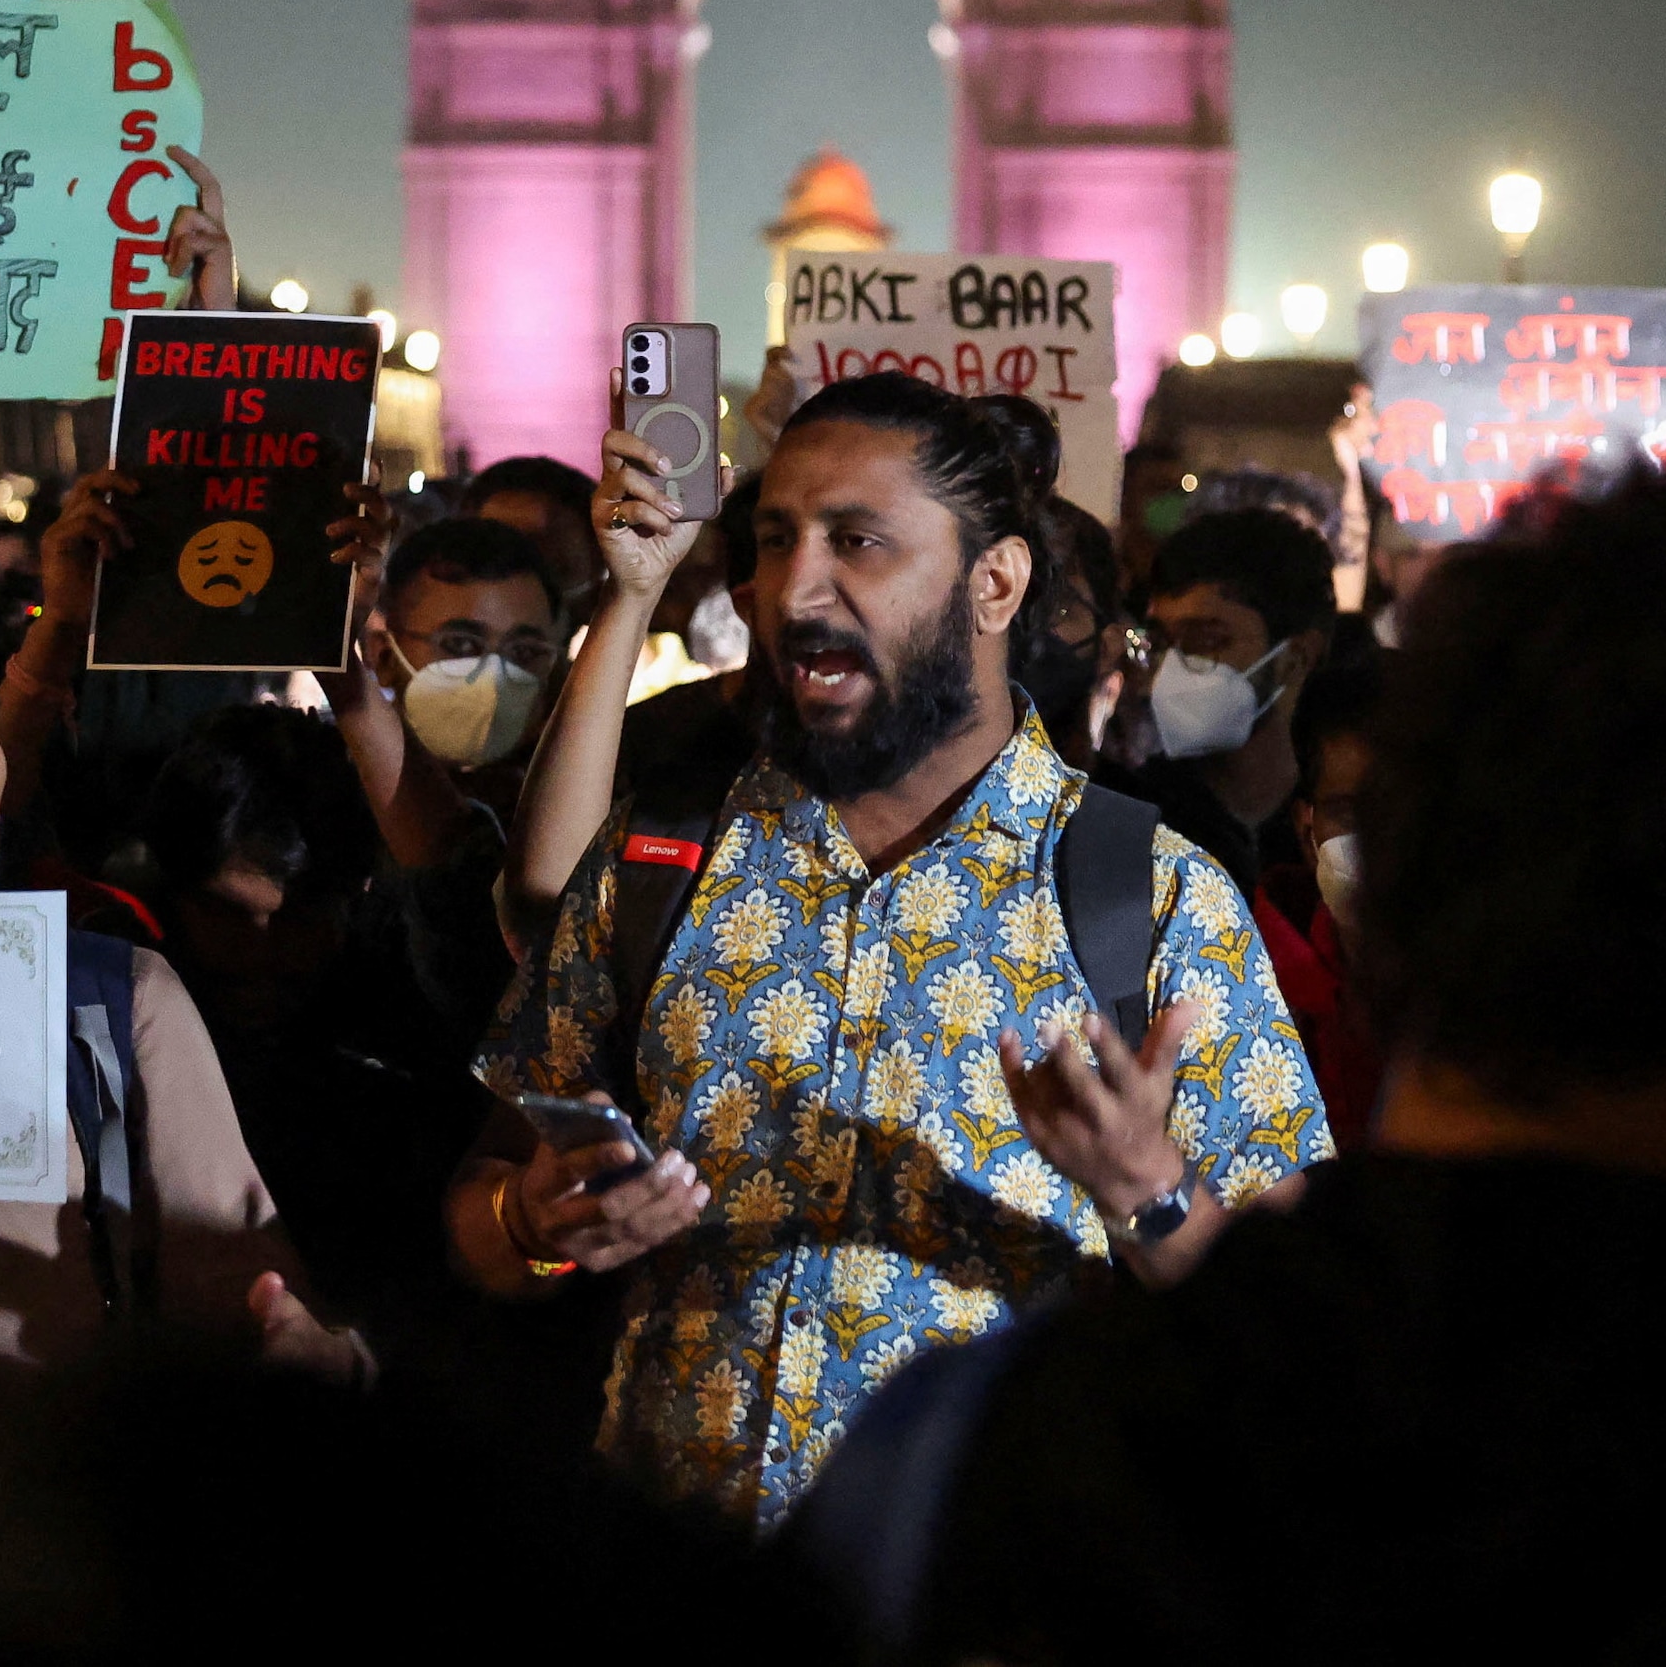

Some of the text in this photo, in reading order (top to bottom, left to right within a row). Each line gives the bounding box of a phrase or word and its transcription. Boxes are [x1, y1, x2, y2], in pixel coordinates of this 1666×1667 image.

[788, 262, 1094, 333] ABKI BAAR
[135, 340, 368, 383] BREATHING
[222, 387, 267, 424] IS
[145, 427, 320, 470] KILLING
[202, 476, 268, 513] ME
[642, 843, 679, 856] Lenovo
